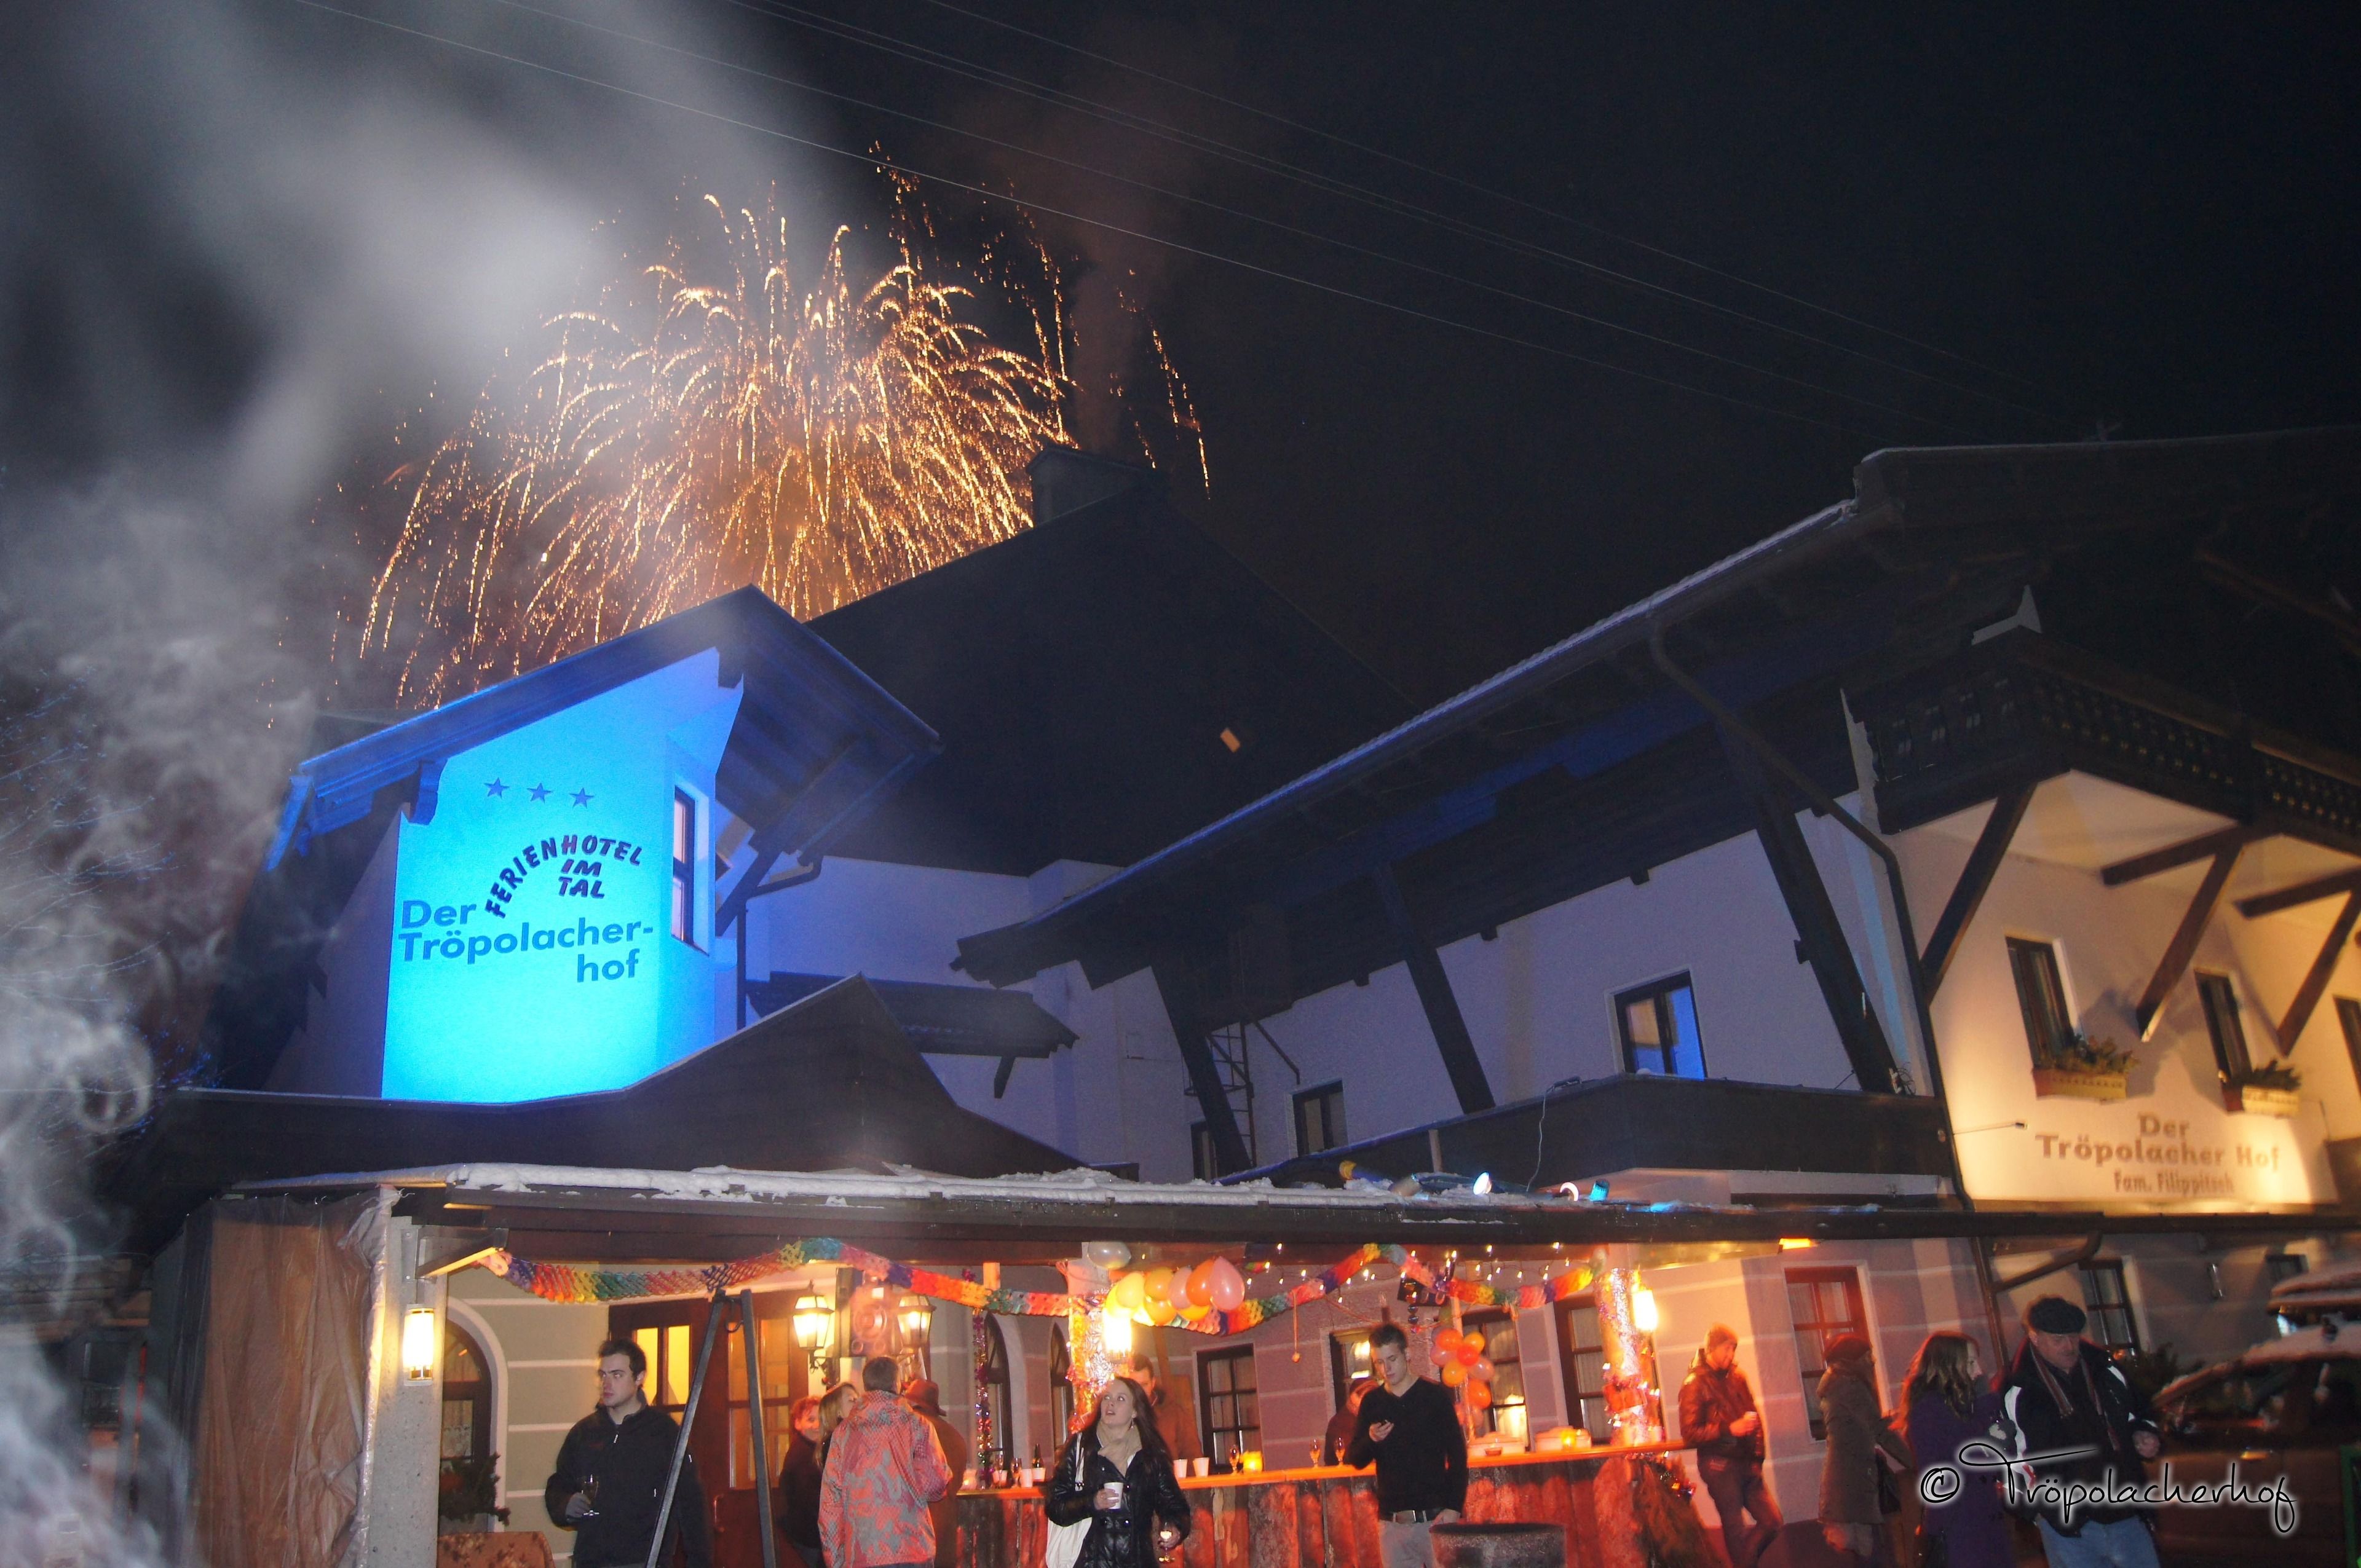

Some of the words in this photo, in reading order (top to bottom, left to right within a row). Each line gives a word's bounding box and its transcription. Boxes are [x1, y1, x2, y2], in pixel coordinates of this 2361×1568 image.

[484, 835, 644, 919] FERIENHOTEL
[561, 859, 602, 877] IM
[558, 877, 605, 899] TAL
[401, 900, 477, 929] Der
[398, 917, 653, 965] Tröpolacher-
[577, 949, 639, 983] hof
[2137, 1112, 2191, 1138] Der
[2035, 1133, 2226, 1166] Tröpolacher
[2236, 1146, 2280, 1172] Hof
[2114, 1172, 2151, 1192] Fam.
